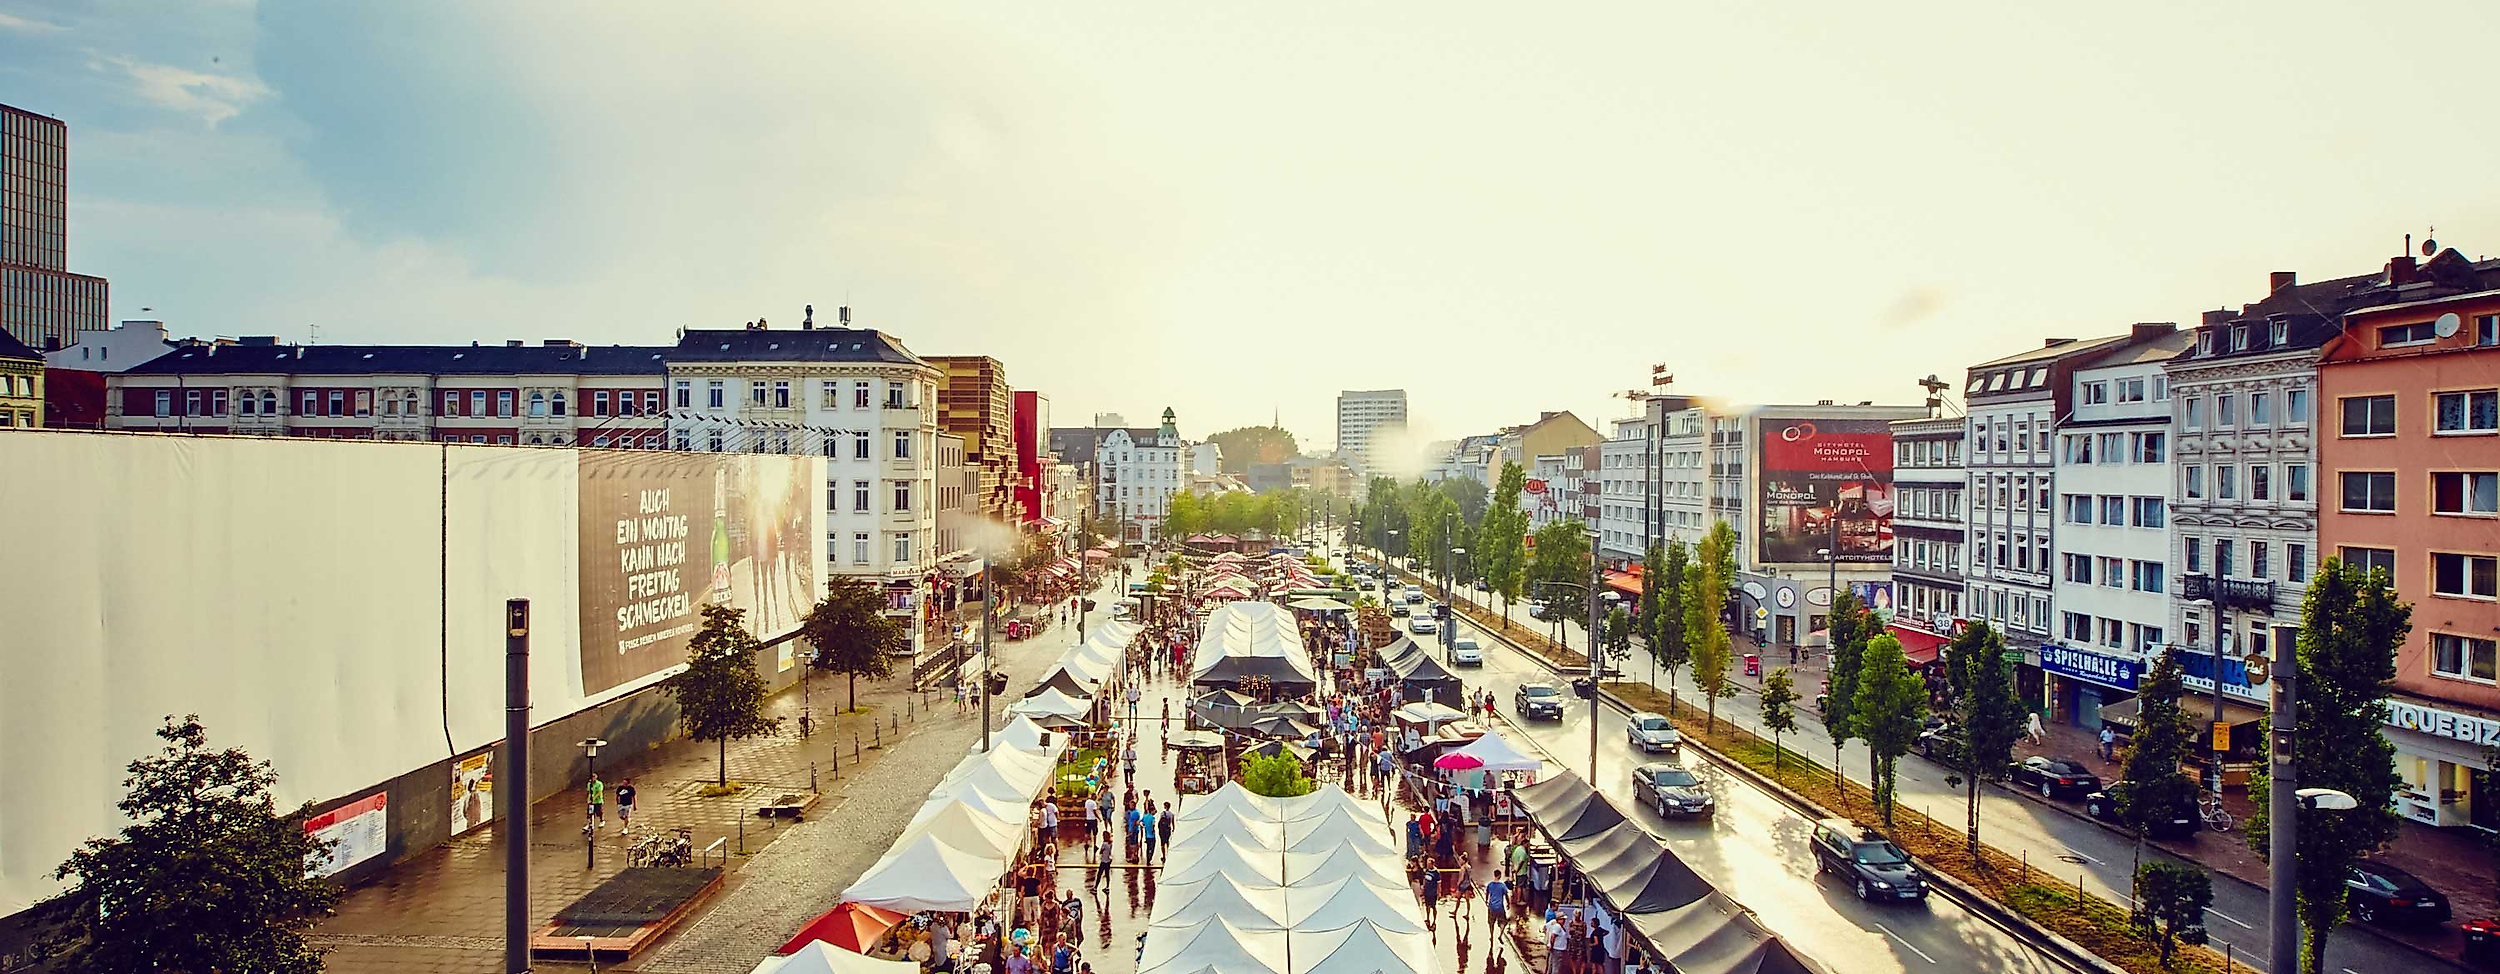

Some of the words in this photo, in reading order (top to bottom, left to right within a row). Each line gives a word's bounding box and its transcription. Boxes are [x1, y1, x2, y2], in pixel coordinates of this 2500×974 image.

[1813, 448, 1870, 456] MONOPOL
[640, 488, 669, 514] AUCH
[1766, 491, 1817, 500] MONOPOL
[617, 517, 638, 544] EIN
[641, 515, 688, 542] MONTAG
[621, 545, 654, 573] KANN
[656, 541, 686, 567] NACH
[628, 568, 681, 600] FREITAG
[617, 591, 692, 632] SCHMECKEN.
[1937, 619, 1950, 628] 38
[2054, 649, 2117, 676] SPIELHALLE
[1239, 674, 1271, 690] BAR
[2222, 685, 2253, 697] OSTEL
